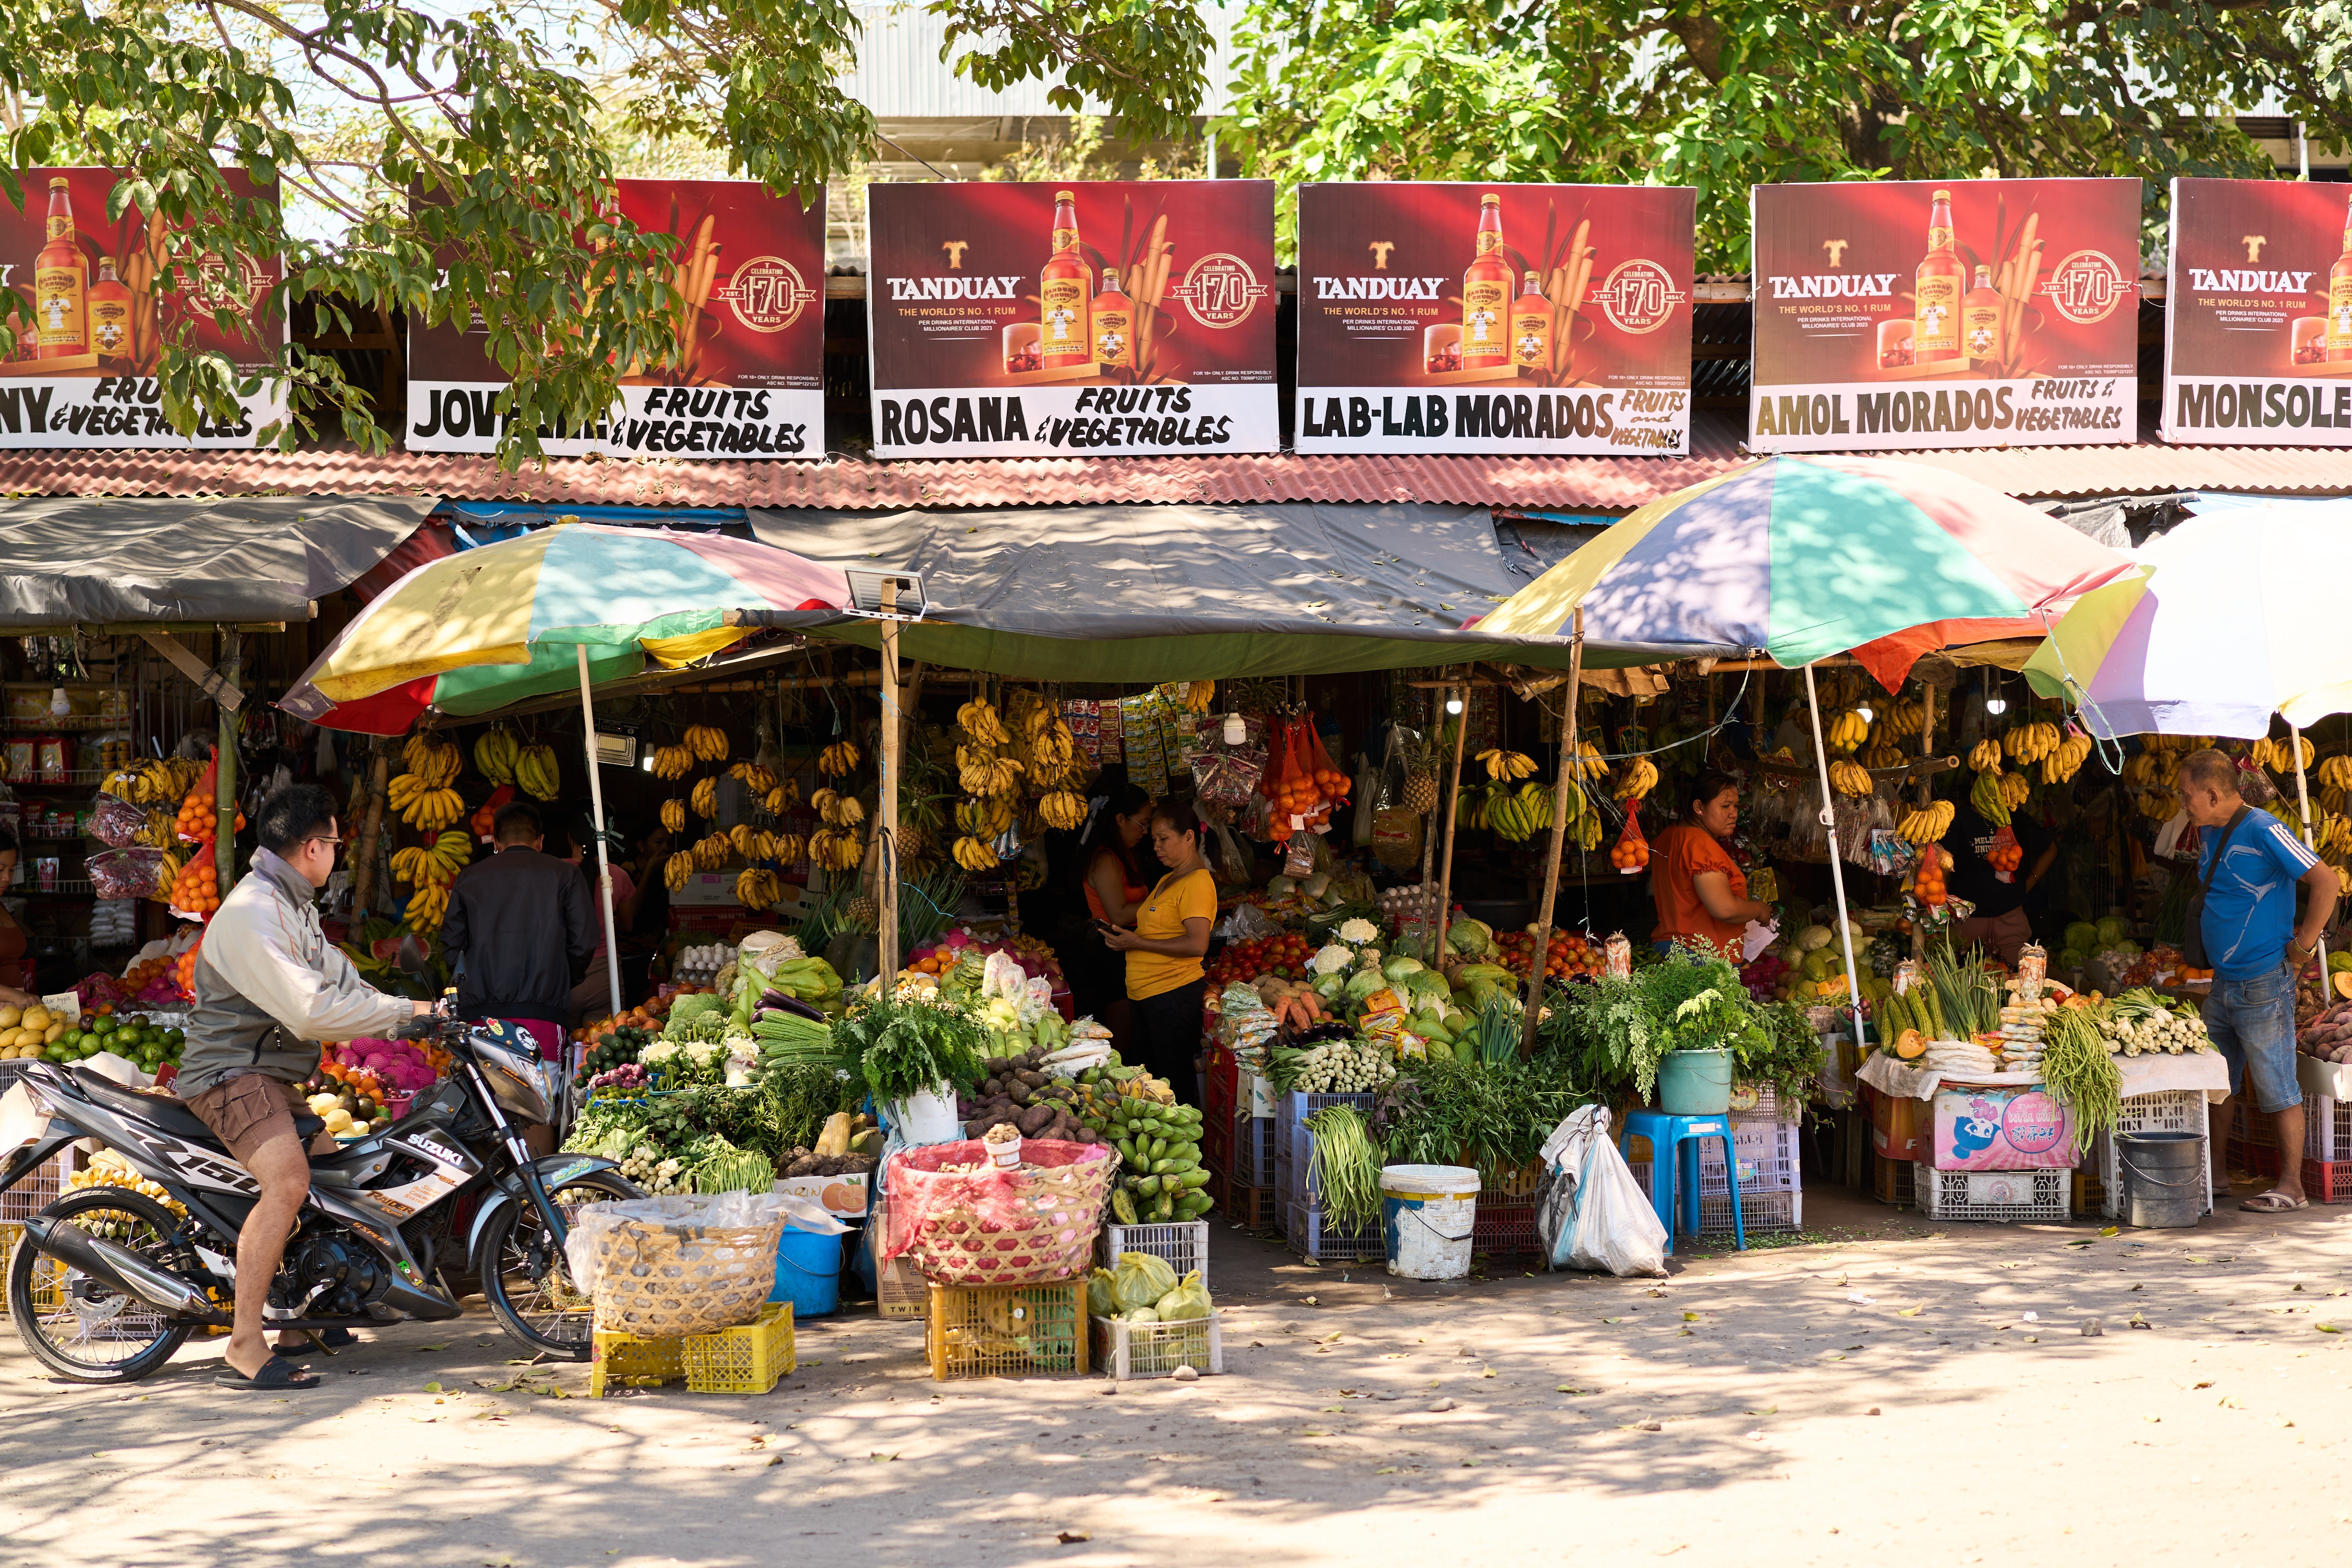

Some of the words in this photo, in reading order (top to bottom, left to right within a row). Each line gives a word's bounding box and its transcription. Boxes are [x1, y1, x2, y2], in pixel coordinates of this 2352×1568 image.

[887, 276, 1020, 299] TANDUAY
[1193, 273, 1247, 311] 170
[1312, 275, 1444, 301] TANDUAY
[1768, 274, 1896, 298] TANDUAY
[2060, 269, 2113, 307] 170
[2188, 267, 2312, 294] TANDUAY
[739, 275, 796, 316] 170
[1611, 278, 1666, 317] 170
[2218, 298, 2259, 308] WORLD'S
[2261, 300, 2277, 308] NO.
[2286, 301, 2306, 309] RUM
[1344, 307, 1388, 316] WORLD'S
[1391, 307, 1407, 316] NO.
[1075, 387, 1191, 414] FRUITS
[1620, 390, 1686, 412] FRUITS
[2032, 380, 2097, 399] FRUITS
[644, 388, 771, 420] FRUITS
[1303, 395, 1448, 437] LAB-LAB
[1455, 394, 1614, 440] MORADOS
[1757, 394, 1849, 435] AMOL
[1857, 387, 2013, 433] MORADOS
[68, 405, 253, 437] VEGETALES
[881, 397, 1029, 445] ROSANA
[1050, 416, 1234, 447] VEGETABLES
[2016, 407, 2122, 431] VEGETABLES
[626, 419, 807, 454] VEGETABLES
[1610, 426, 1684, 450] VEGETABLES
[57, 995, 71, 1004] Apple
[2007, 1112, 2034, 1123] YUM
[2036, 1111, 2062, 1122] YUM
[195, 1149, 219, 1160] HYPER
[407, 1134, 464, 1165] SUZUKI
[365, 1190, 416, 1215] RAIDER
[404, 1194, 425, 1205] SYSTEM
